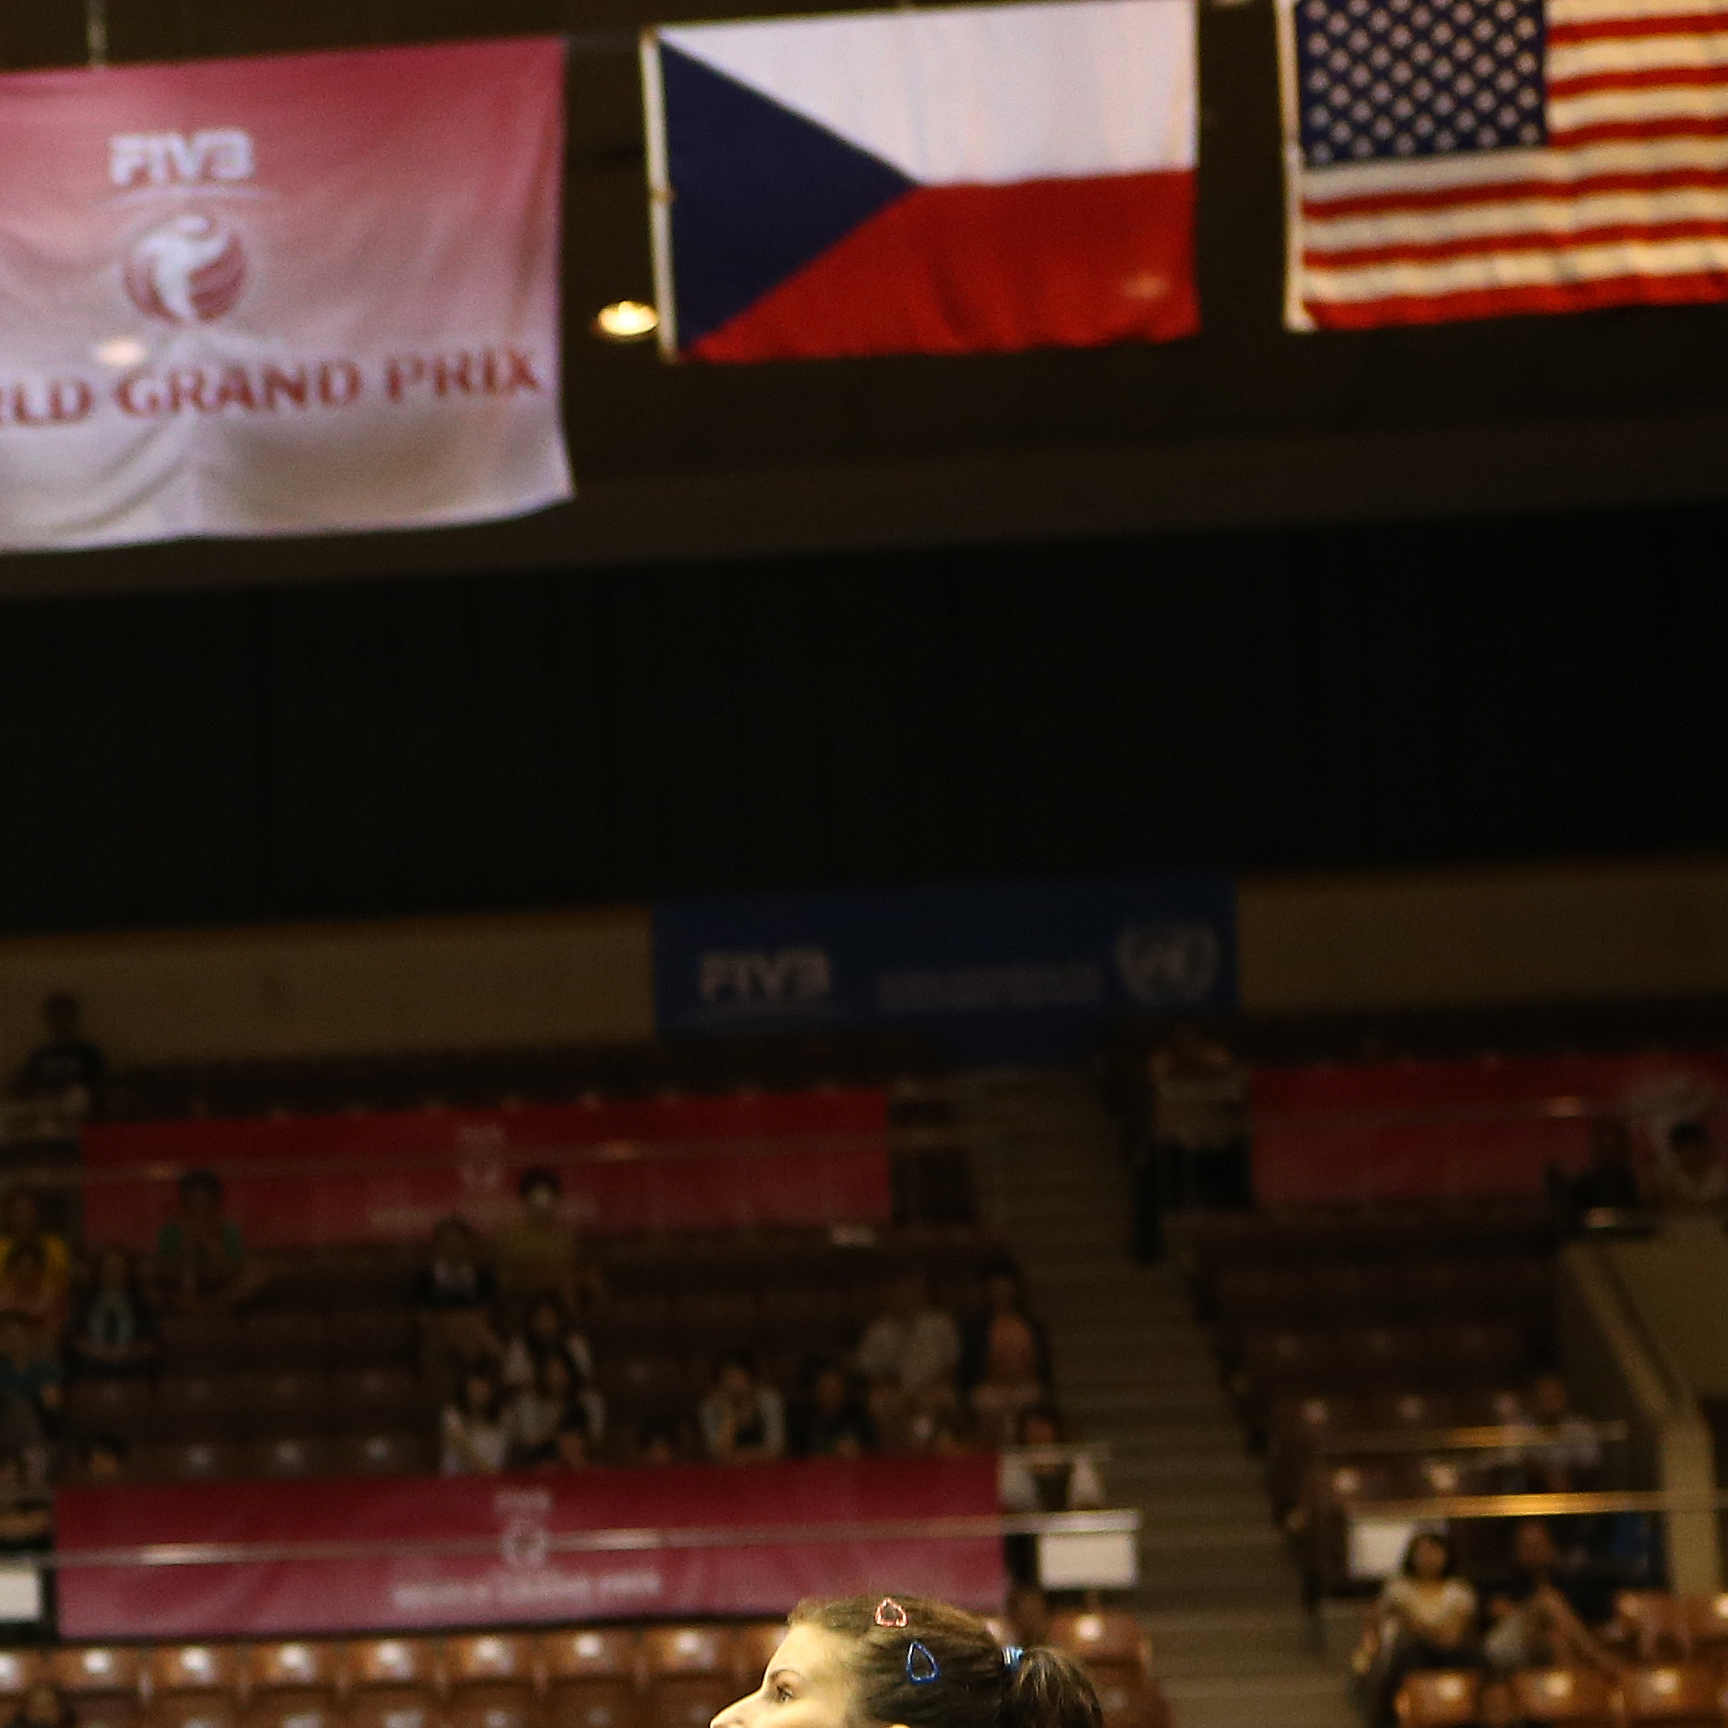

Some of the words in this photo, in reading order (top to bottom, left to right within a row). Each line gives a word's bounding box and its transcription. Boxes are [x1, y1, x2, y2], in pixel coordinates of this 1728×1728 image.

[107, 127, 256, 186] FIVB
[114, 361, 365, 420] GRAND
[382, 346, 542, 403] PRIX
